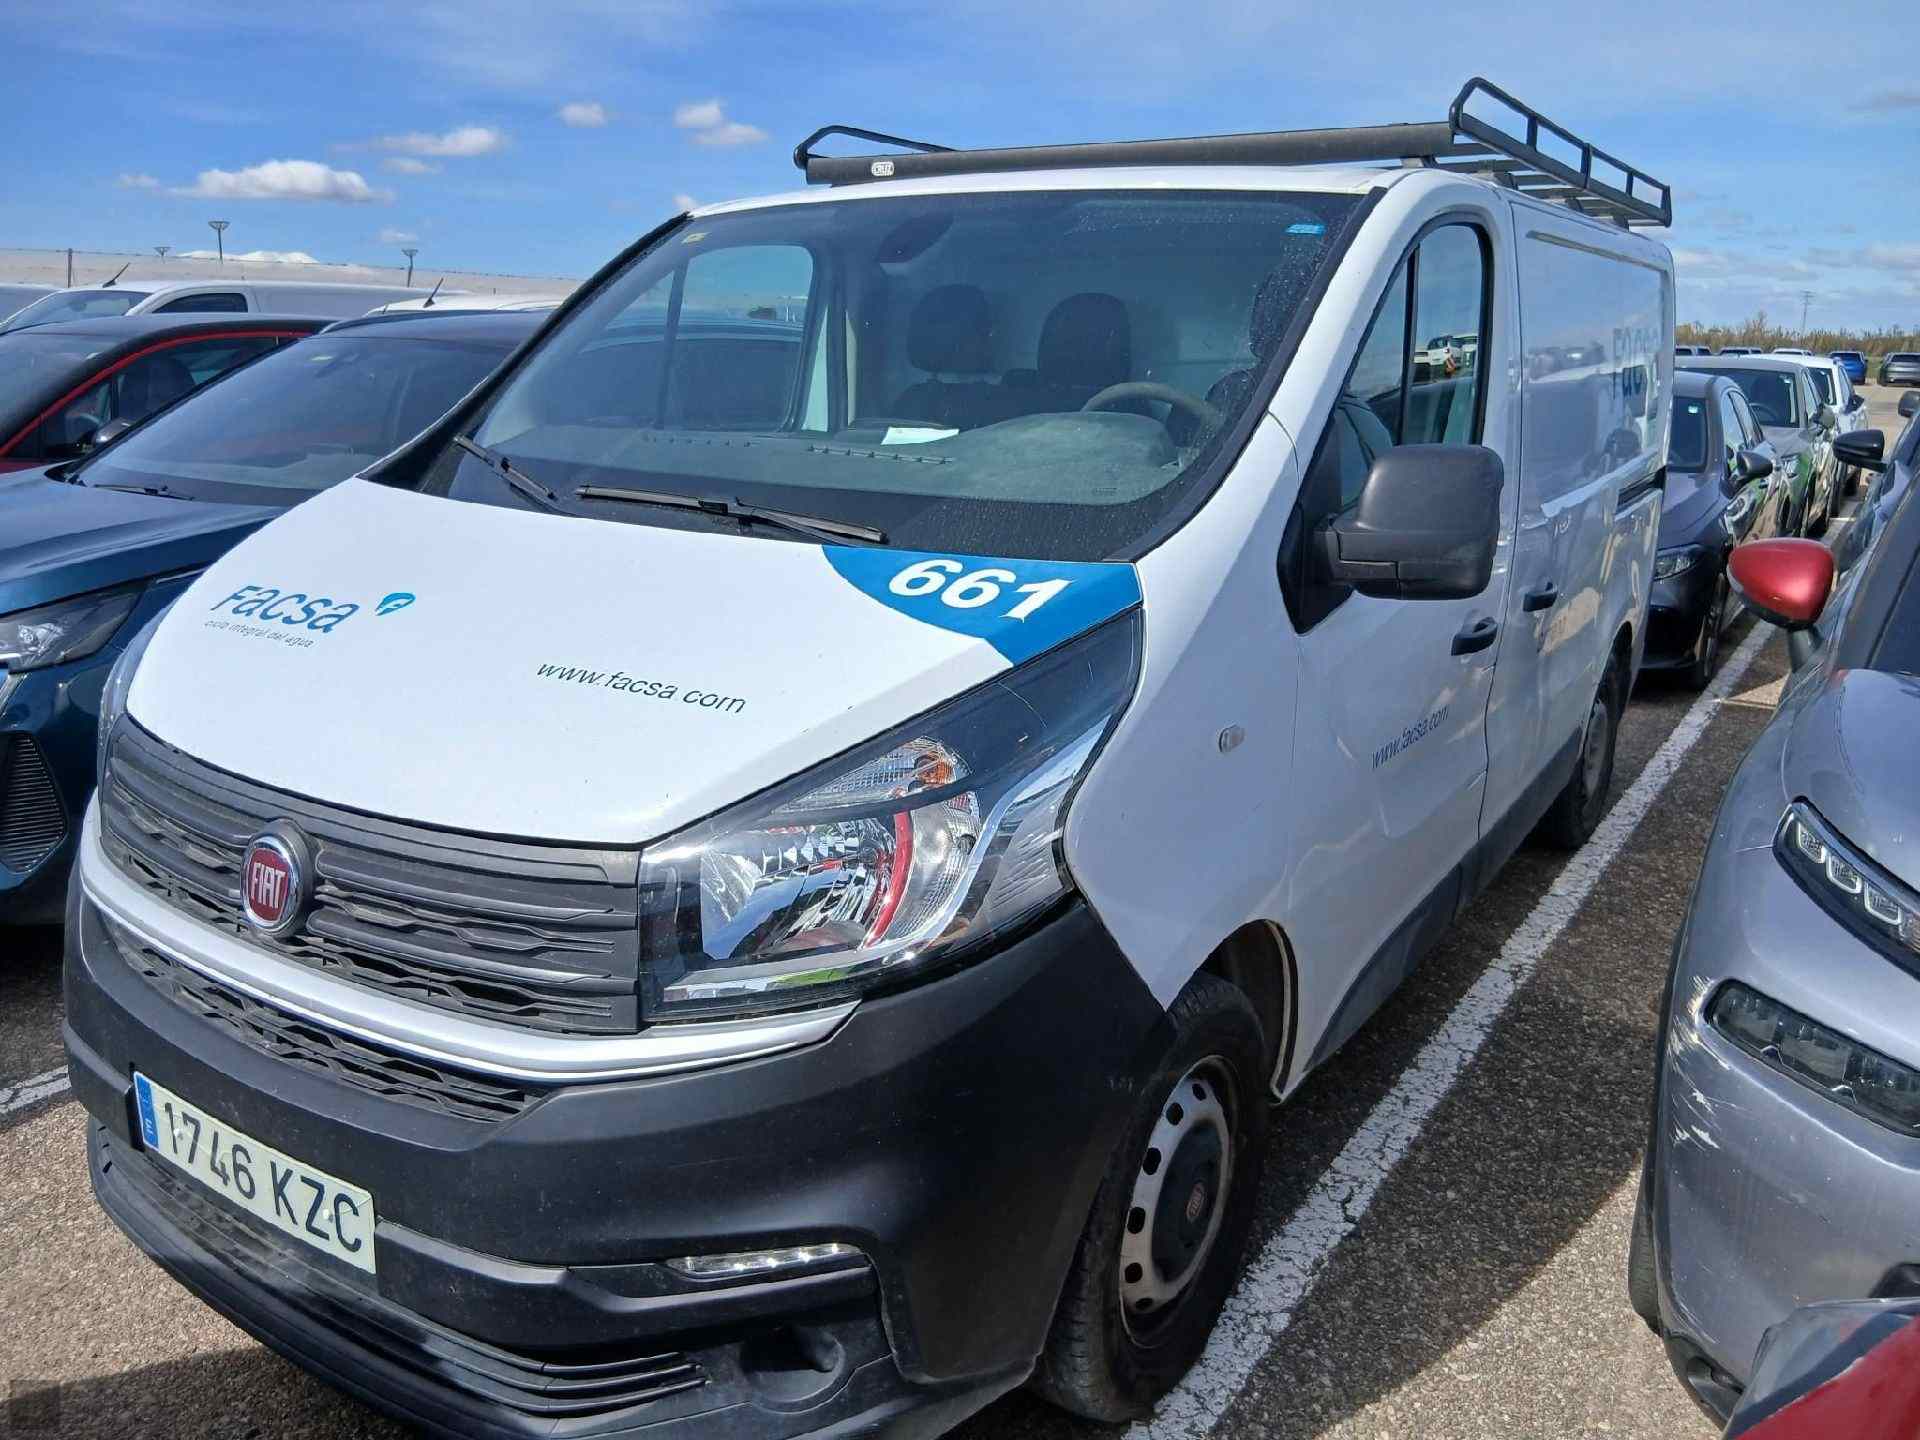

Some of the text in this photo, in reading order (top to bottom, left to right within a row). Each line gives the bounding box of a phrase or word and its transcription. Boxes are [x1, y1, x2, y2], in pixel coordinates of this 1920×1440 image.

[210, 586, 360, 633] Facsa
[888, 559, 1073, 622] 661
[1371, 704, 1449, 769] www.facsa.com
[251, 862, 286, 909] FIAT
[165, 1102, 362, 1253] 1746 KZC
